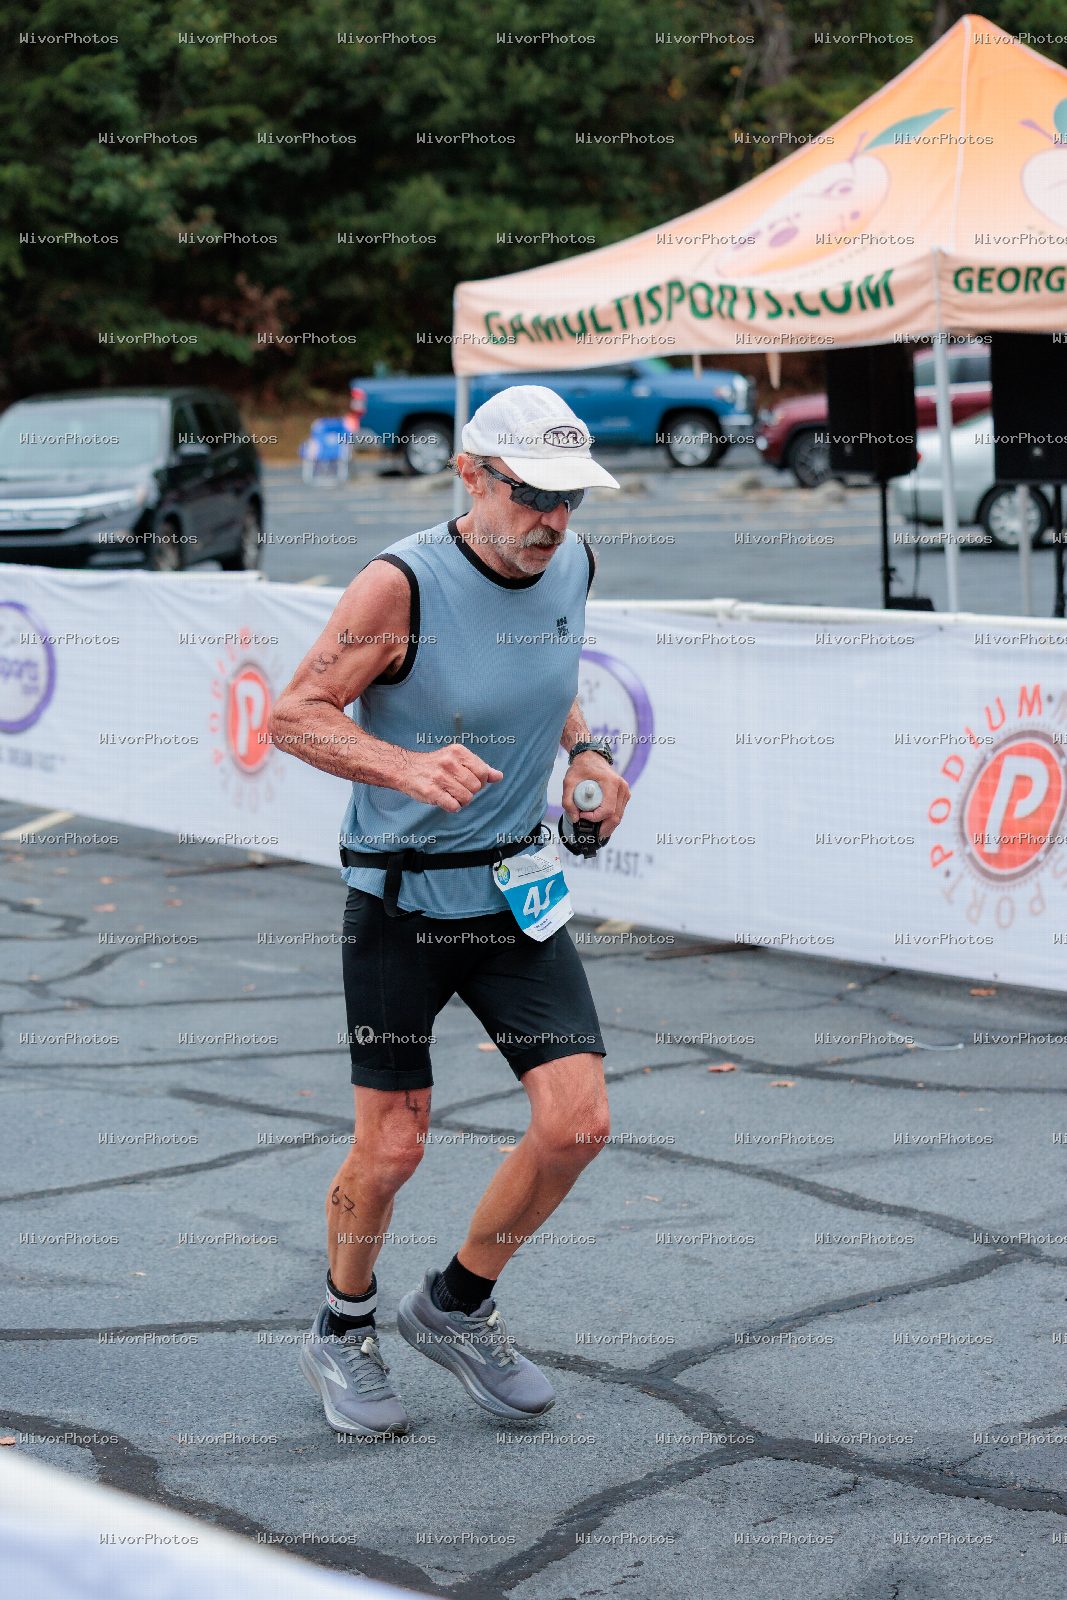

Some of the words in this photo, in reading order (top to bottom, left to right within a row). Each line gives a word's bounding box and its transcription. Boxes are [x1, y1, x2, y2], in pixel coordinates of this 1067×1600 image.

[484, 268, 896, 345] GAMULTISPORTS.COM
[928, 683, 1043, 868] PODIUM
[983, 754, 1049, 854] P
